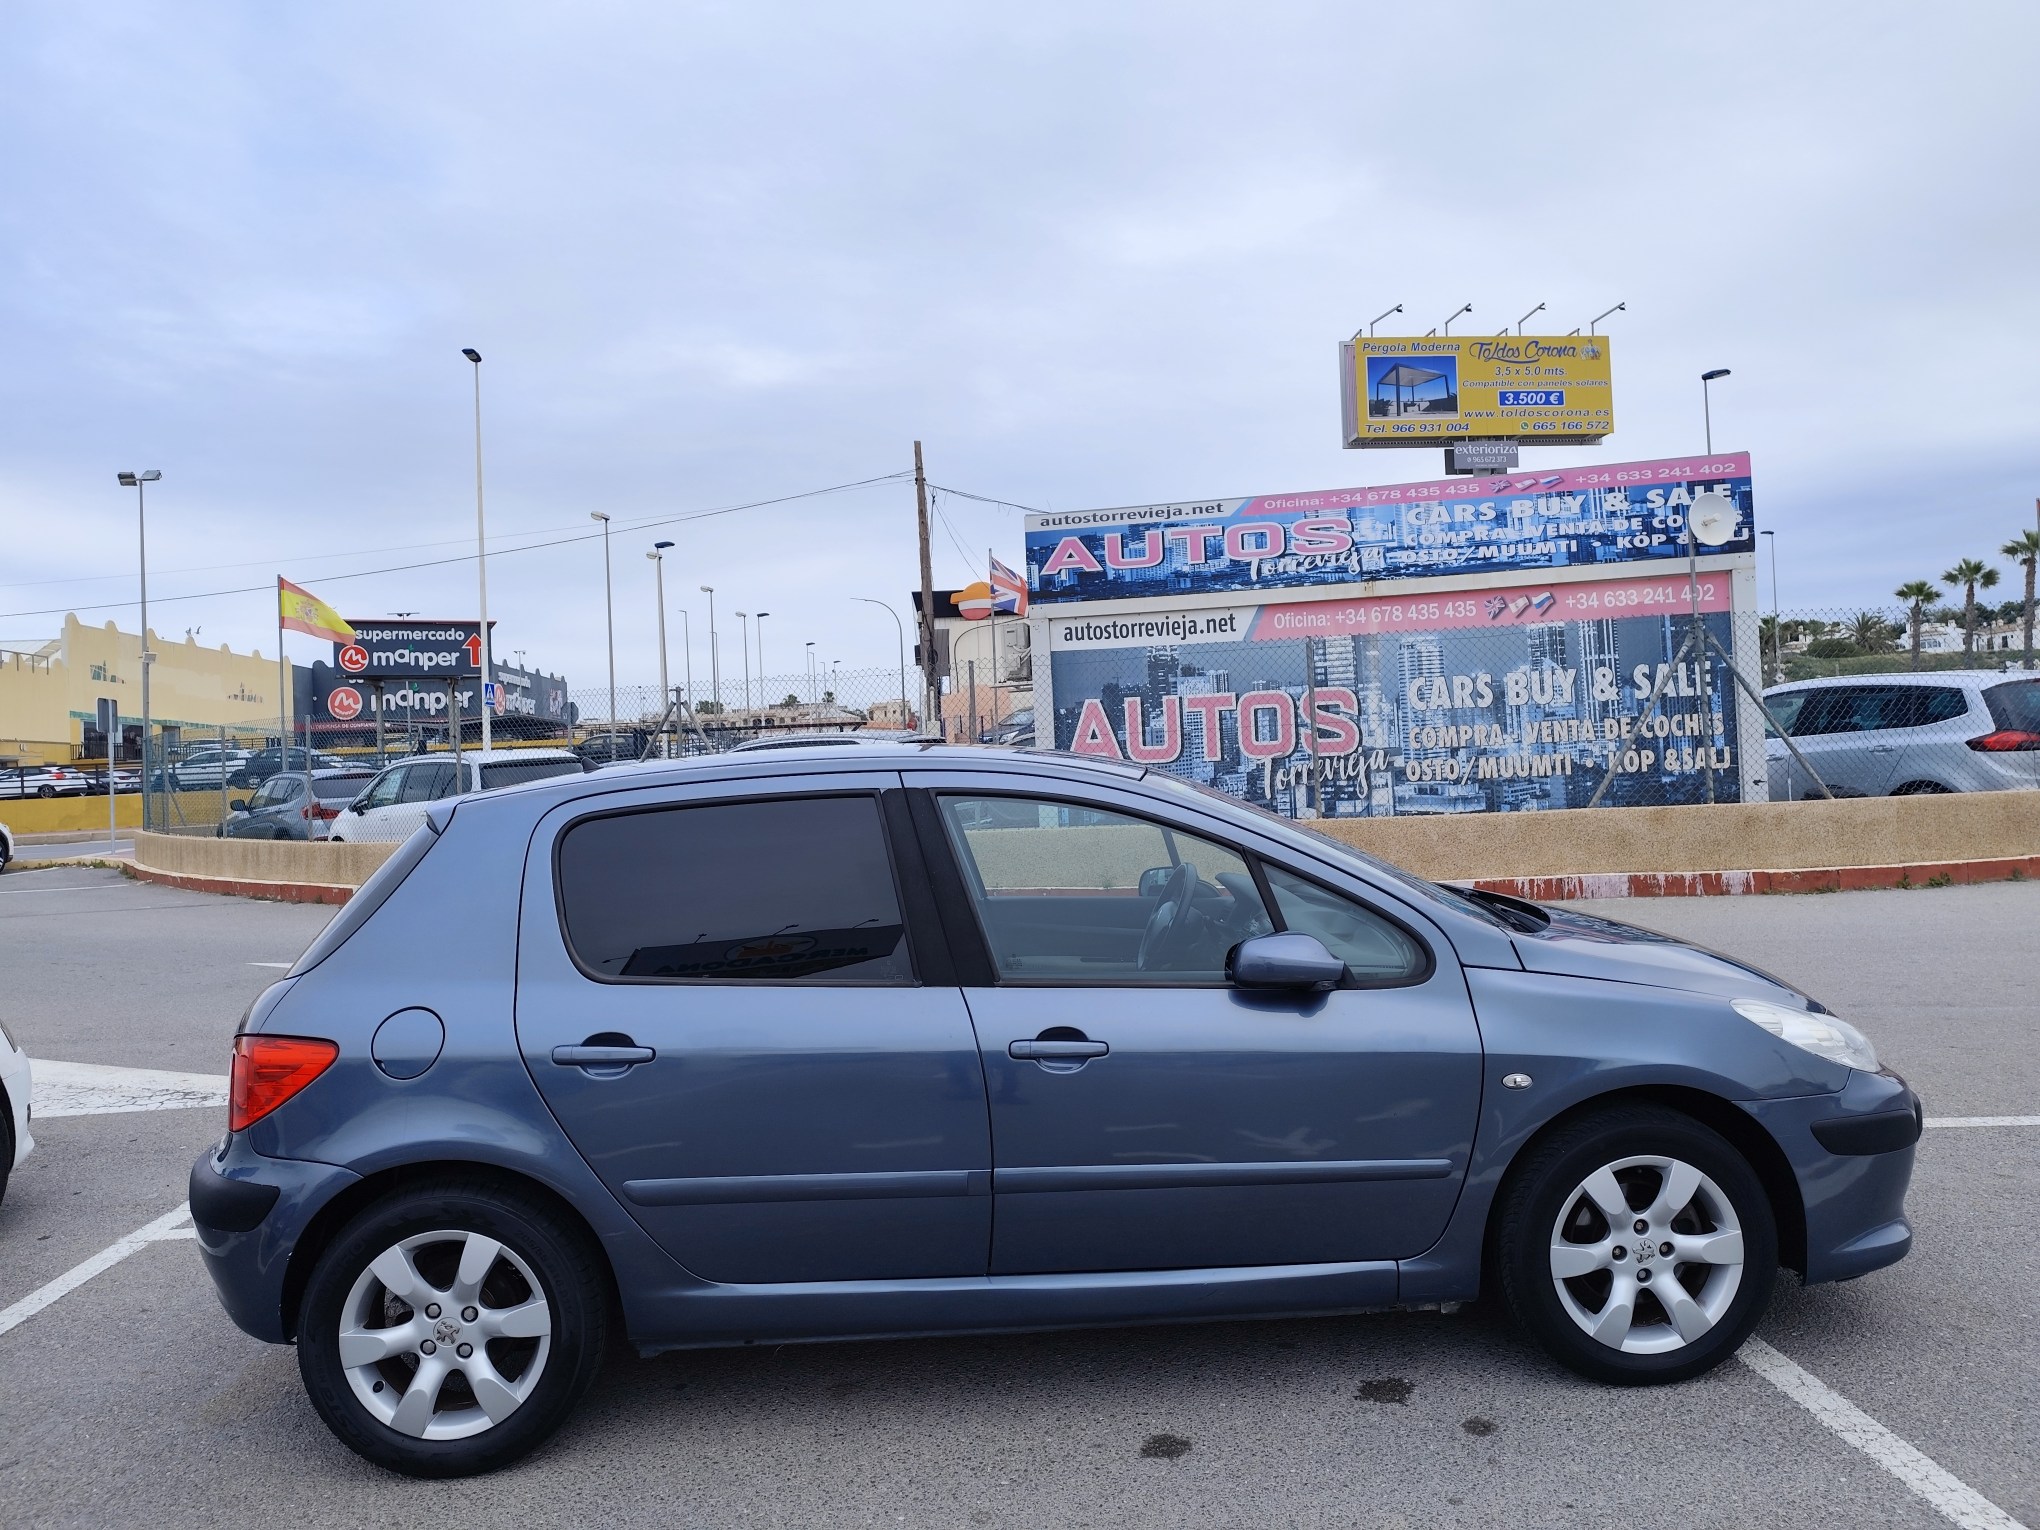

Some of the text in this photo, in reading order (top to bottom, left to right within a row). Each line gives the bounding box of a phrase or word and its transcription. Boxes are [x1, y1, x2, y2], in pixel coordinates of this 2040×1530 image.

[1410, 342, 1460, 352] Moderna
[1469, 340, 1578, 362] Toldos Corona
[1462, 380, 1515, 388] Compatible
[1537, 379, 1573, 388] paneles
[1575, 379, 1609, 387] solares
[1544, 366, 1567, 376] mts.
[1464, 408, 1609, 418] www.toldoscorona.es
[1505, 392, 1560, 404] 3.500 €
[1365, 422, 1470, 434] Tel. 966 931 004
[1532, 420, 1609, 432] 665 166 572
[1455, 444, 1518, 455] exterioriza
[1263, 463, 1736, 509] Oficina: +34 678 435 435 +34 633 241 402
[1039, 502, 1225, 528] autostorrevieja.net
[1406, 501, 1498, 526] CARS
[1510, 494, 1588, 519] BUY
[1604, 491, 1632, 512] &
[1400, 539, 1578, 562] OSTO/MUUMTI
[1616, 531, 1667, 549] KÖP
[1404, 527, 1509, 547] COMPRA
[1526, 519, 1605, 539] VENTA
[1613, 517, 1643, 532] DE
[1040, 519, 1356, 576] AUTOS
[1241, 546, 1384, 581] Torrevieja
[1273, 583, 1715, 630] Oficina: +34 678 435 435 +34 633 241 402
[355, 628, 465, 643] supermercado
[1063, 612, 1237, 643] autostorrevieja.net
[372, 648, 460, 671] manper
[1409, 660, 1713, 711] CARS BUY & SALE
[1069, 686, 1363, 764] AUTOS
[1409, 723, 1504, 750] COMPRA
[1526, 718, 1596, 745] VENTA
[1604, 716, 1632, 741] DE
[1250, 747, 1391, 800] Torrevieja
[1405, 752, 1572, 785] OSTO/MUUMTI
